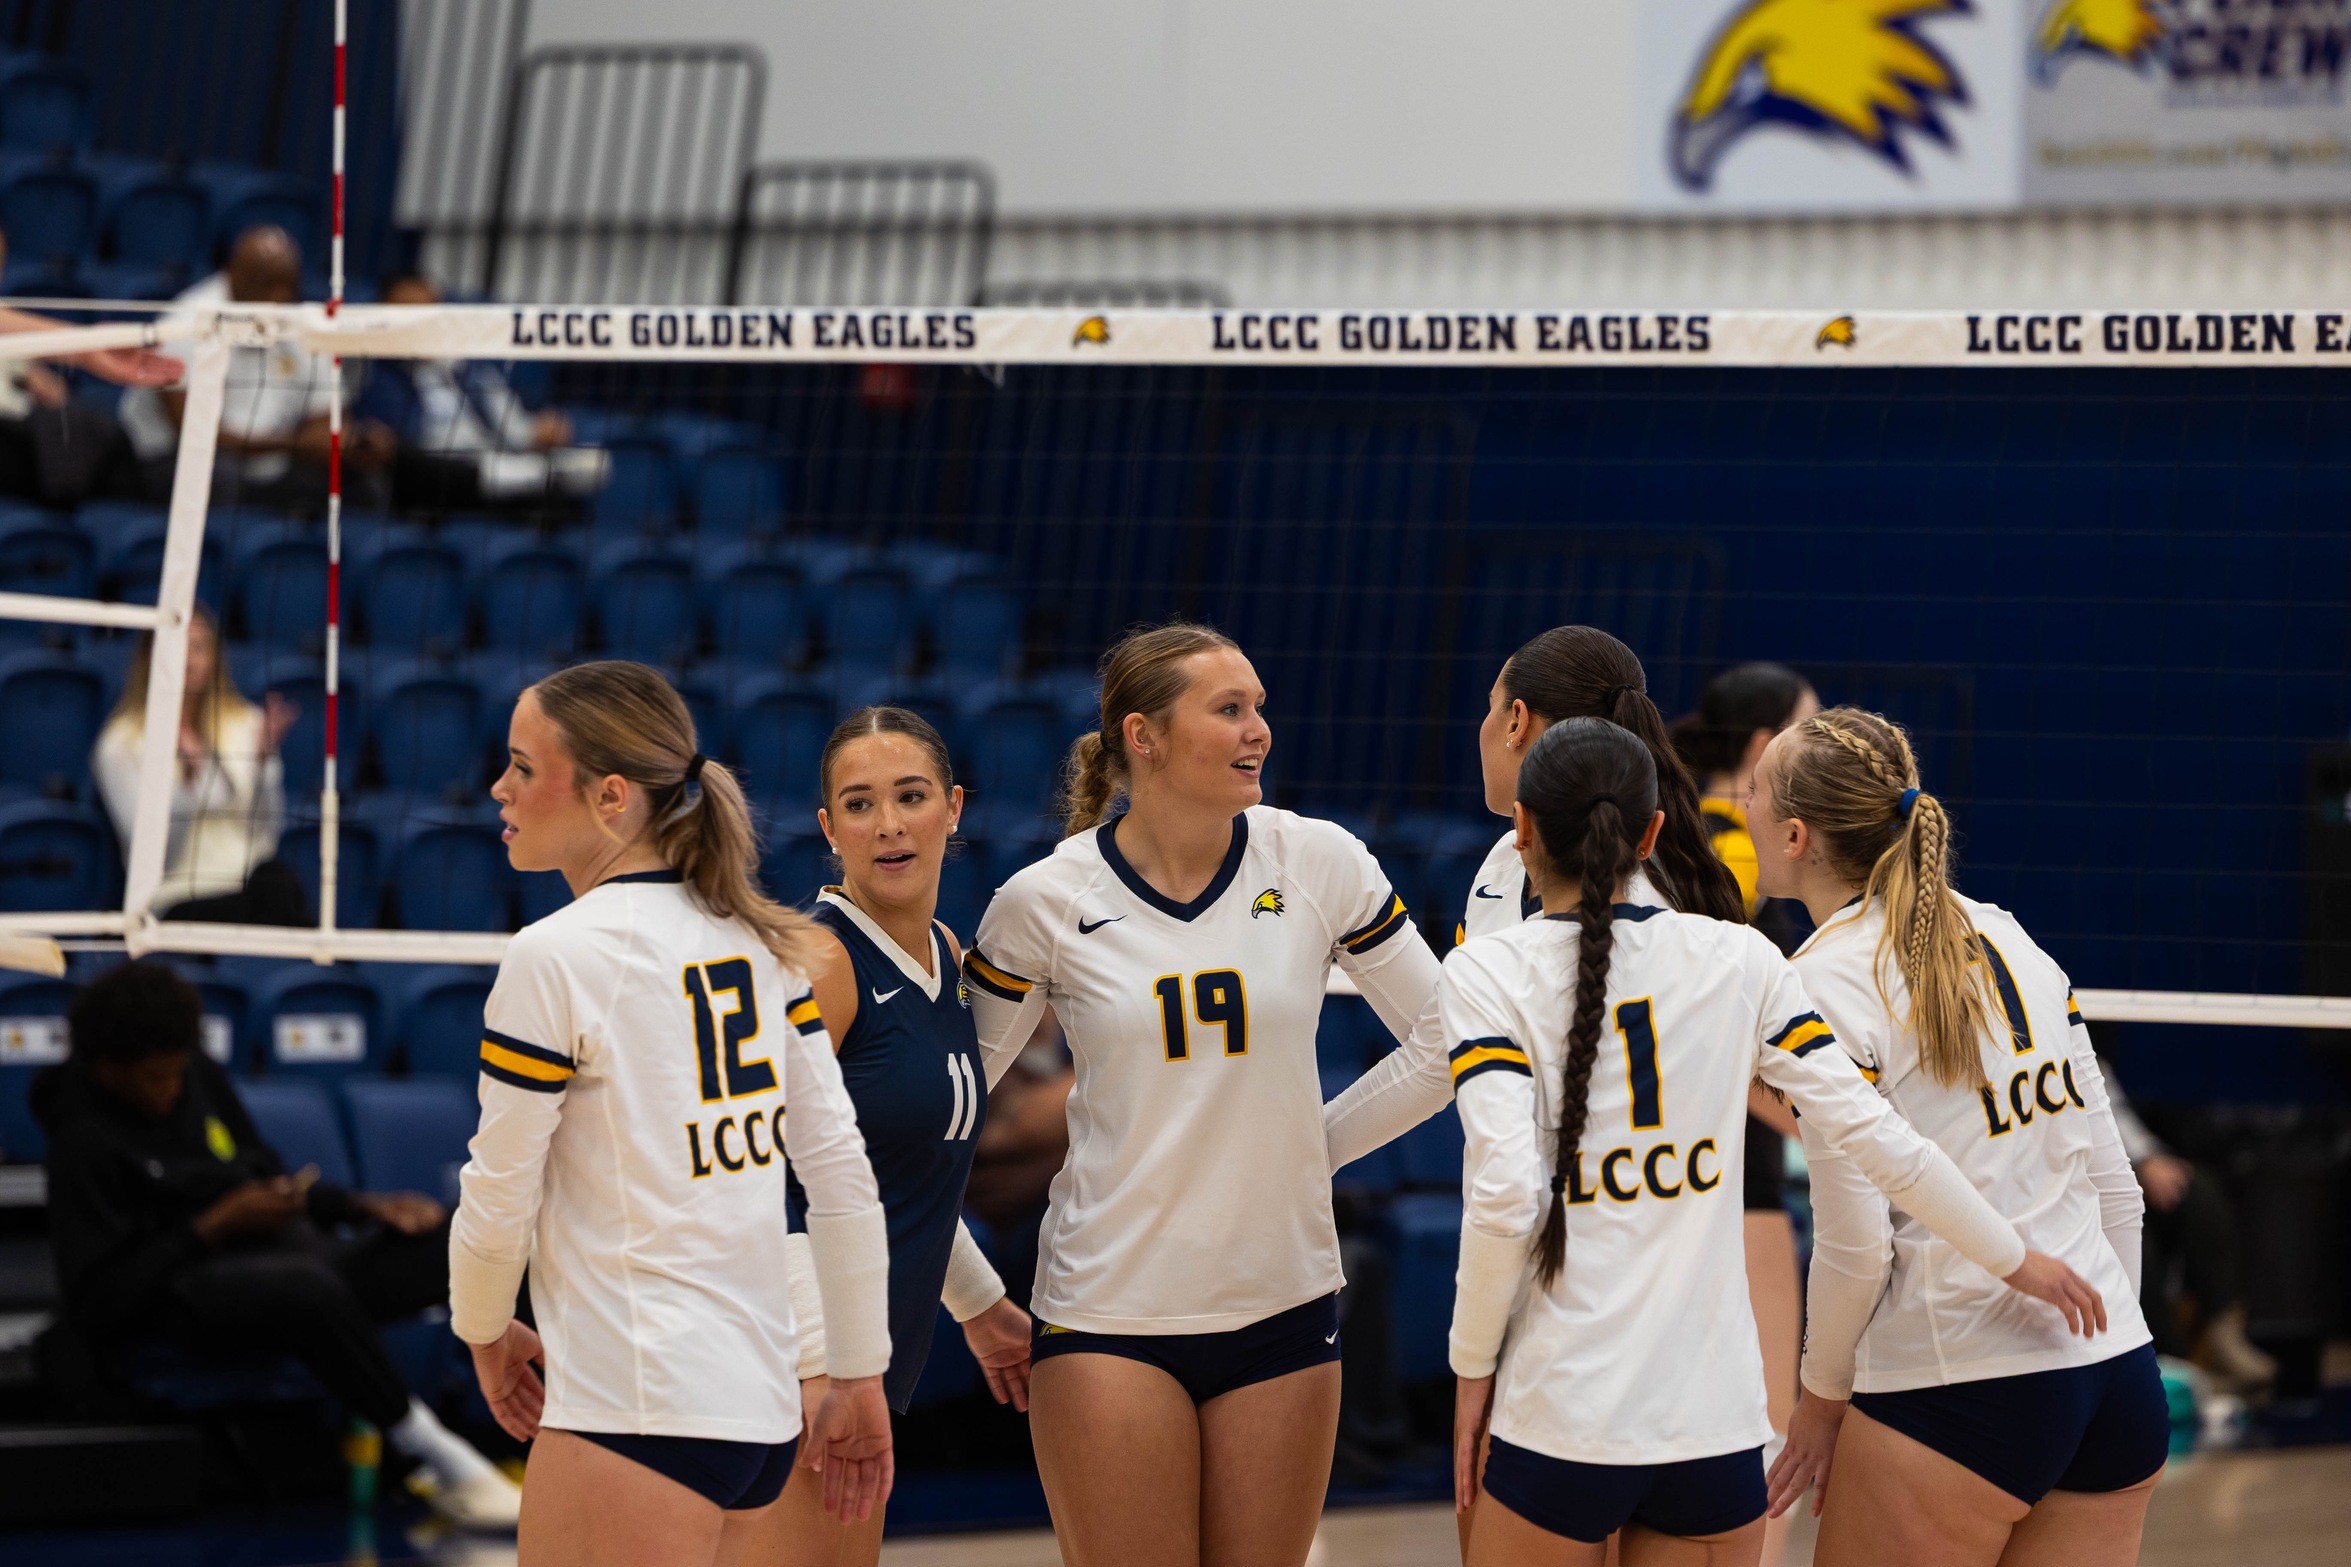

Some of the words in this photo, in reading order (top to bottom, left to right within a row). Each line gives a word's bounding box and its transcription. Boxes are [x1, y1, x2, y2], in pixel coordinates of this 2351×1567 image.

[511, 312, 612, 347] LCCC
[630, 312, 794, 349] GOLDEN
[812, 313, 977, 350] EAGLES
[1211, 314, 1319, 350] LCCC
[1339, 314, 1517, 351] GOLDEN
[1536, 314, 1711, 352] EAGLES
[1966, 315, 2082, 353] LCCC
[2103, 315, 2296, 353] GOLDEN
[2311, 315, 2351, 353] E
[682, 955, 779, 1104] 12
[1152, 967, 1249, 1062] 19
[944, 1052, 977, 1141] 11
[1612, 995, 1664, 1132] 1
[1566, 1137, 1722, 1206] LCCC
